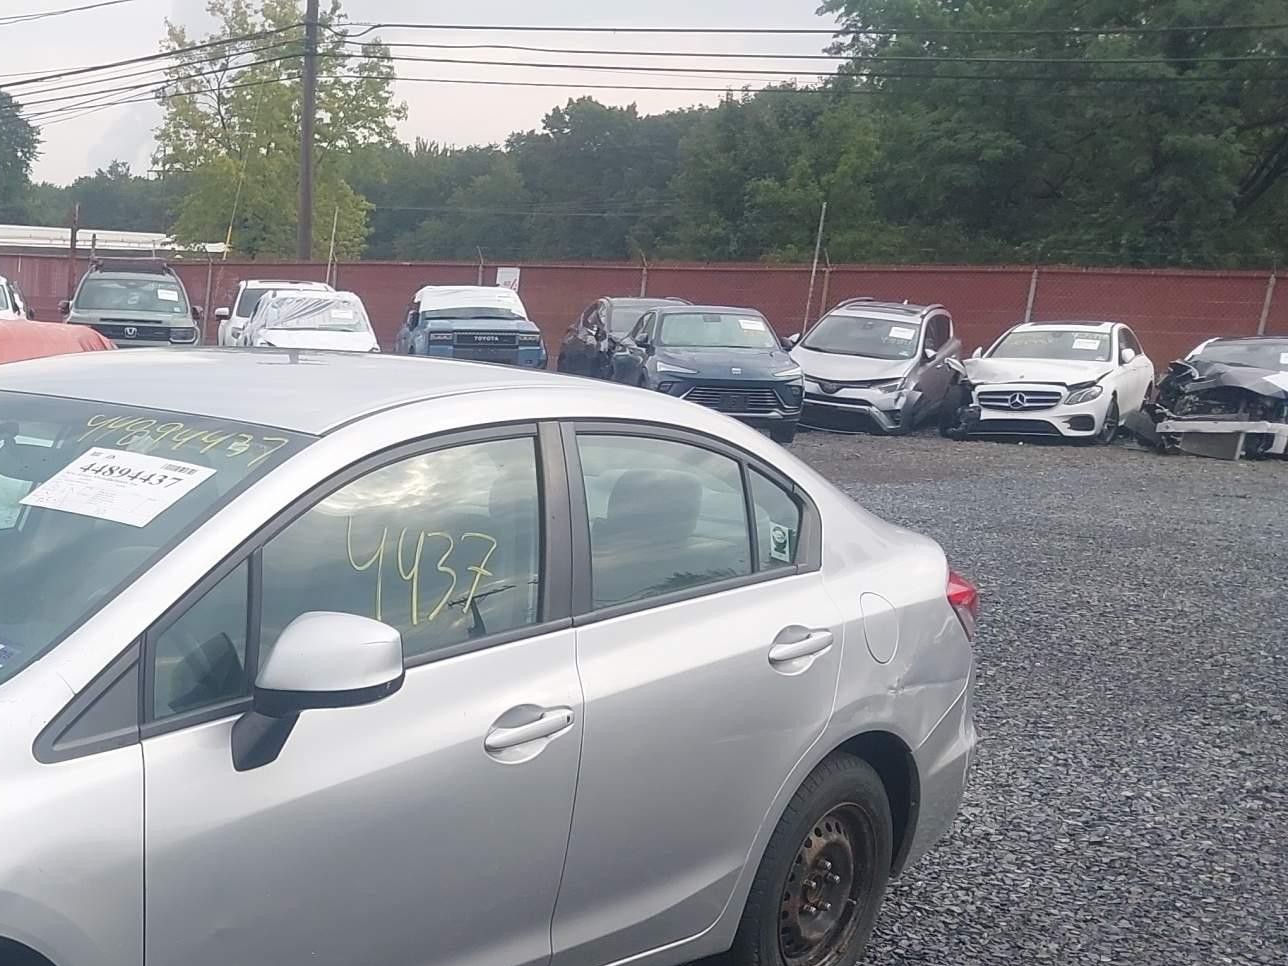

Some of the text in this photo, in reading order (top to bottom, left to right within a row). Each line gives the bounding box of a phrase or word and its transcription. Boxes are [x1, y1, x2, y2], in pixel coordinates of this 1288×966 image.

[77, 414, 288, 467] 44894437
[79, 461, 183, 488] 44894437
[347, 514, 497, 625] 4437
